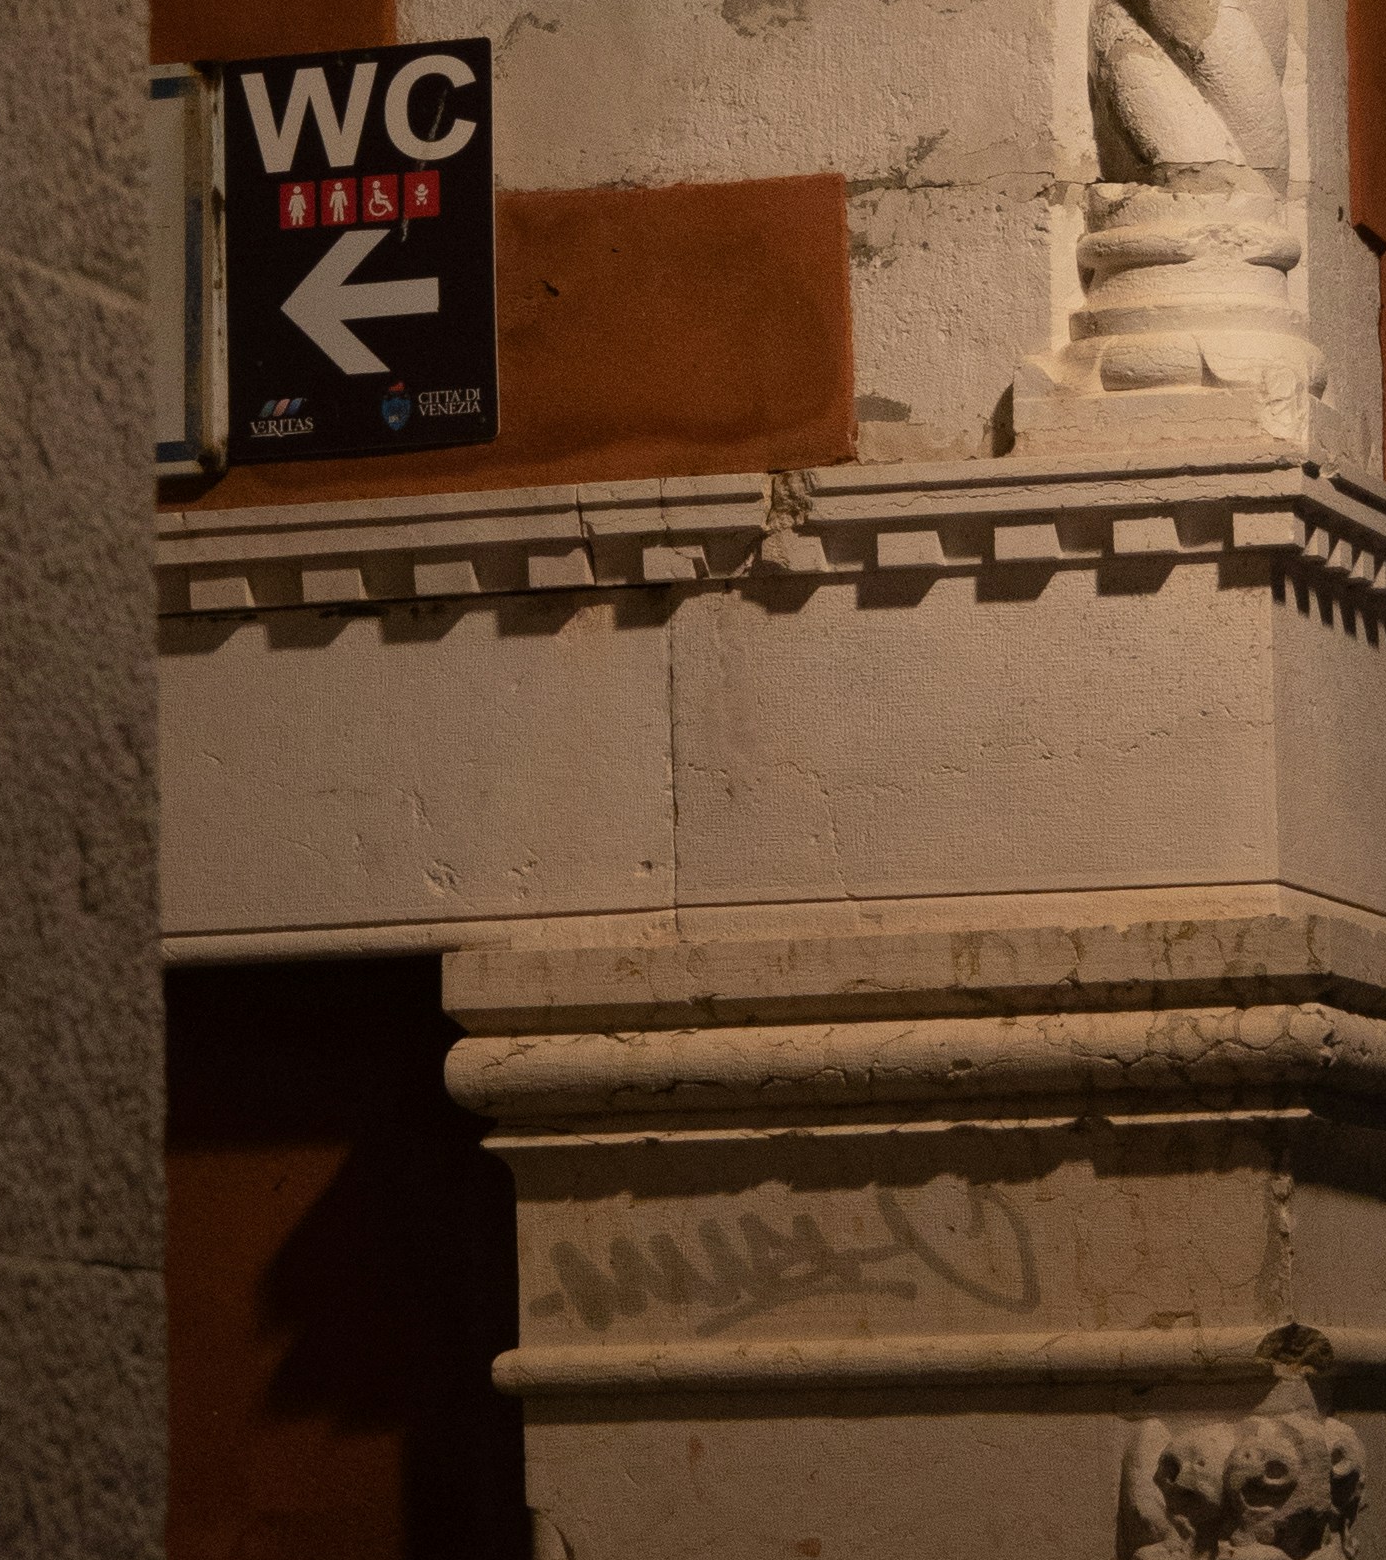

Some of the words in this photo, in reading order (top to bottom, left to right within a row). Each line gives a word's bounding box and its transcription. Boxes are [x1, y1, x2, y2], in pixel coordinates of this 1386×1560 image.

[239, 53, 478, 175] WC
[465, 387, 481, 401] DI
[418, 400, 482, 417] VENEZIA
[249, 415, 315, 437] VERITAS
